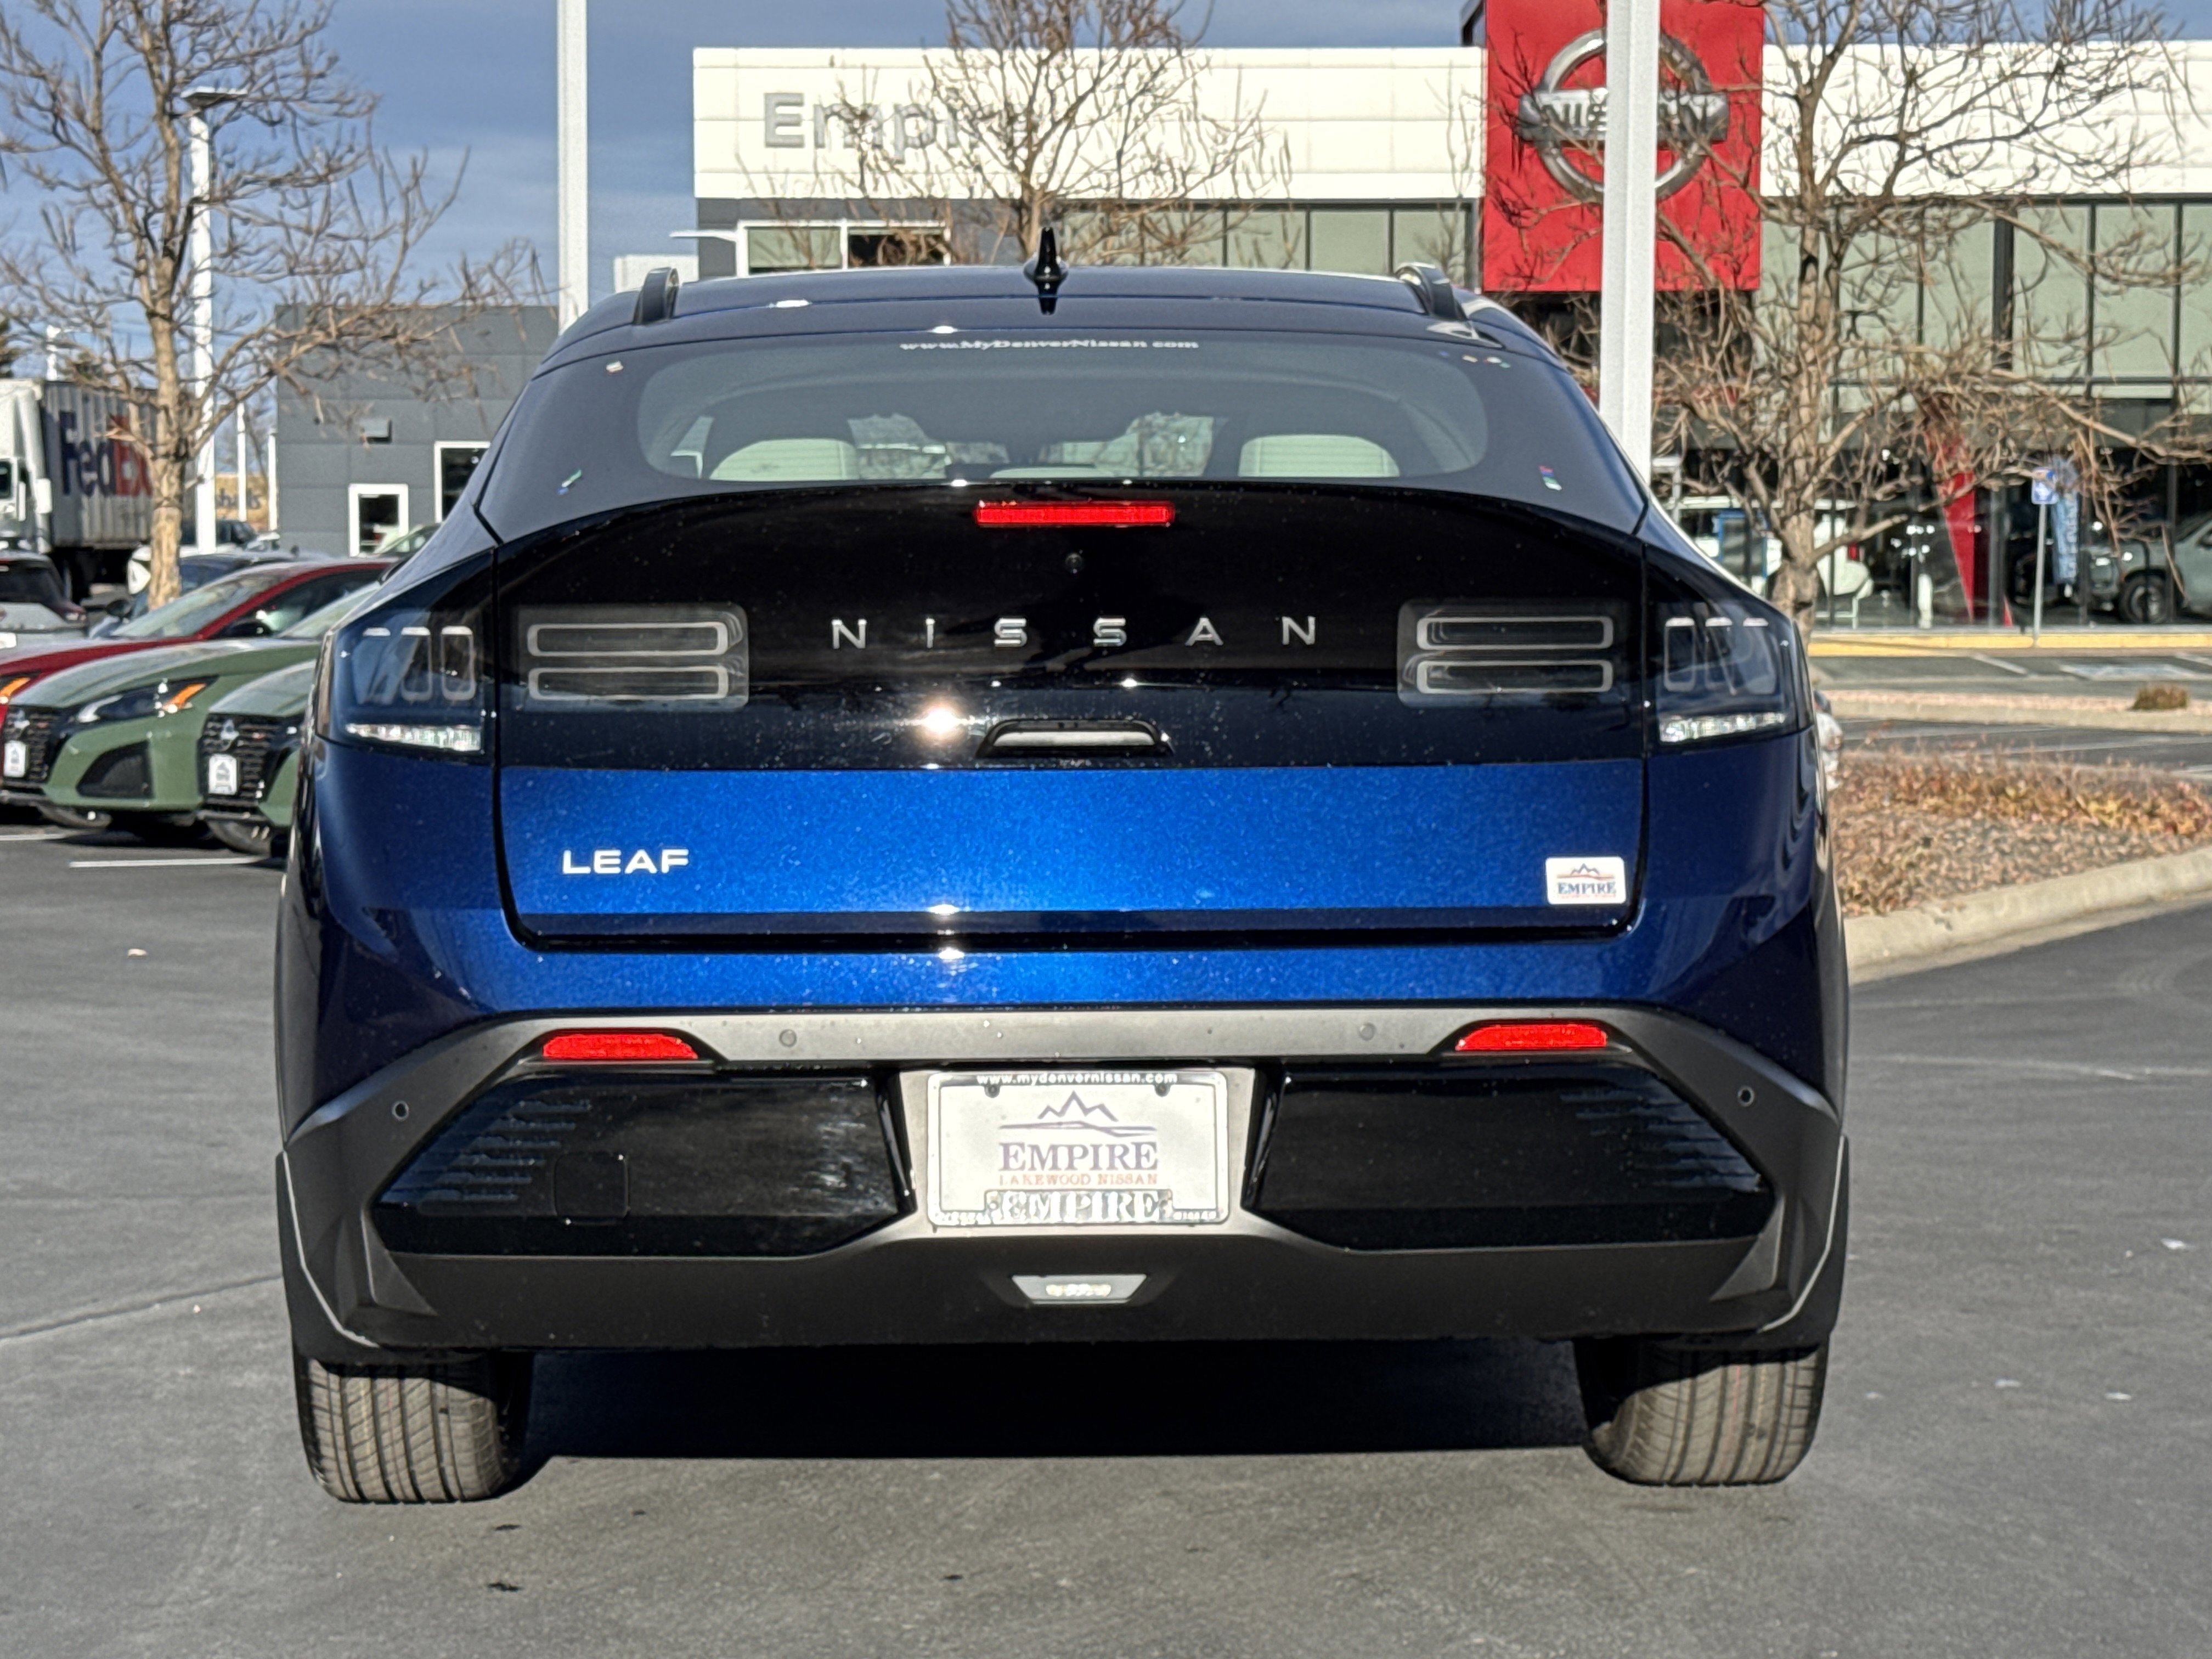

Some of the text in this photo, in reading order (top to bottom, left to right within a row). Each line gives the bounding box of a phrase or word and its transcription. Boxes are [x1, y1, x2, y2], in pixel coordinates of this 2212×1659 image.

[764, 92, 1040, 165] Empi
[899, 340, 1200, 351] www.MyDenverNissancom
[832, 617, 1316, 650] NISSAN
[562, 849, 689, 874] LEAF
[1557, 882, 1617, 895] EMPIRE
[998, 1141, 1159, 1172] EMPIRE
[999, 1173, 1158, 1186] LAKEWOOD NISSAN
[1001, 1190, 1161, 1224] EMPIRE
